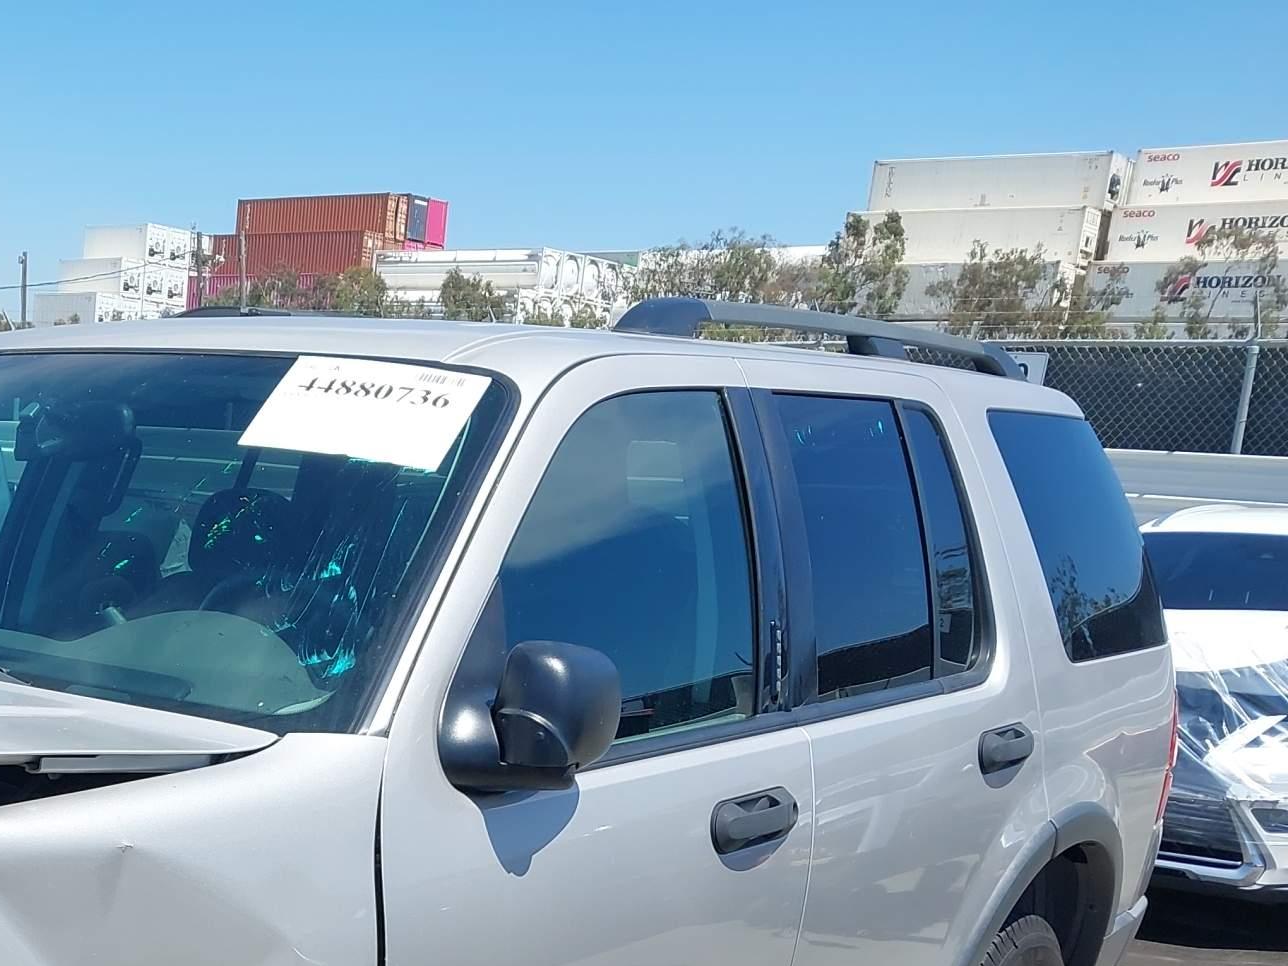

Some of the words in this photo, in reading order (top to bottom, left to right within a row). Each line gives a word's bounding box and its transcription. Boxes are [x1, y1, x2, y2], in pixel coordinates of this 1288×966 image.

[1147, 153, 1180, 162] seaco
[1122, 208, 1156, 218] seaco
[298, 376, 451, 409] 44880736
